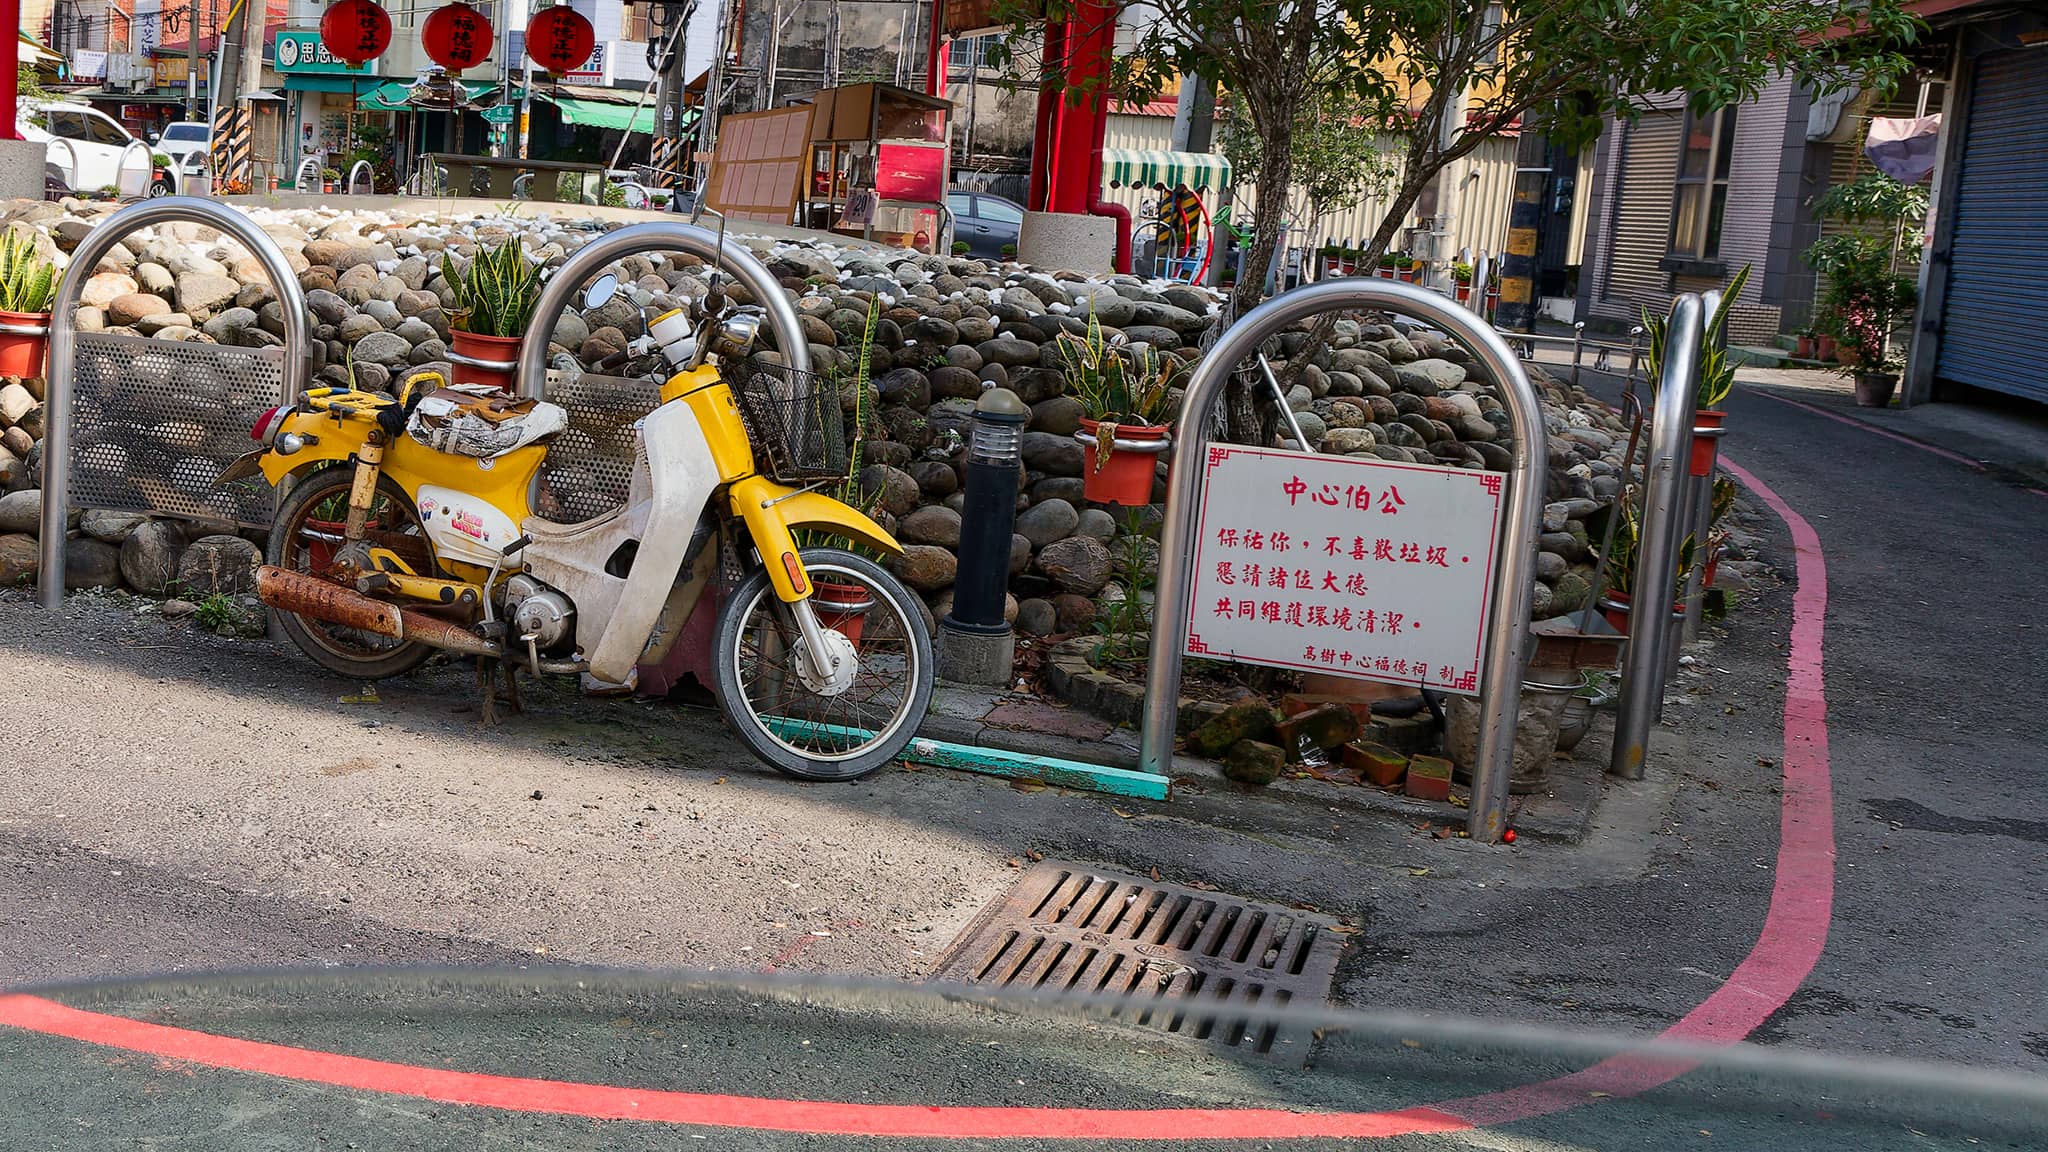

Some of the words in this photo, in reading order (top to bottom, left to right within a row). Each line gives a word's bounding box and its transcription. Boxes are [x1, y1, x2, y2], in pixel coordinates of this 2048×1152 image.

[300, 42, 343, 63] 思恩
[1283, 475, 1406, 515] 中心伯公
[1216, 561, 1369, 597] 懇請諸位大德
